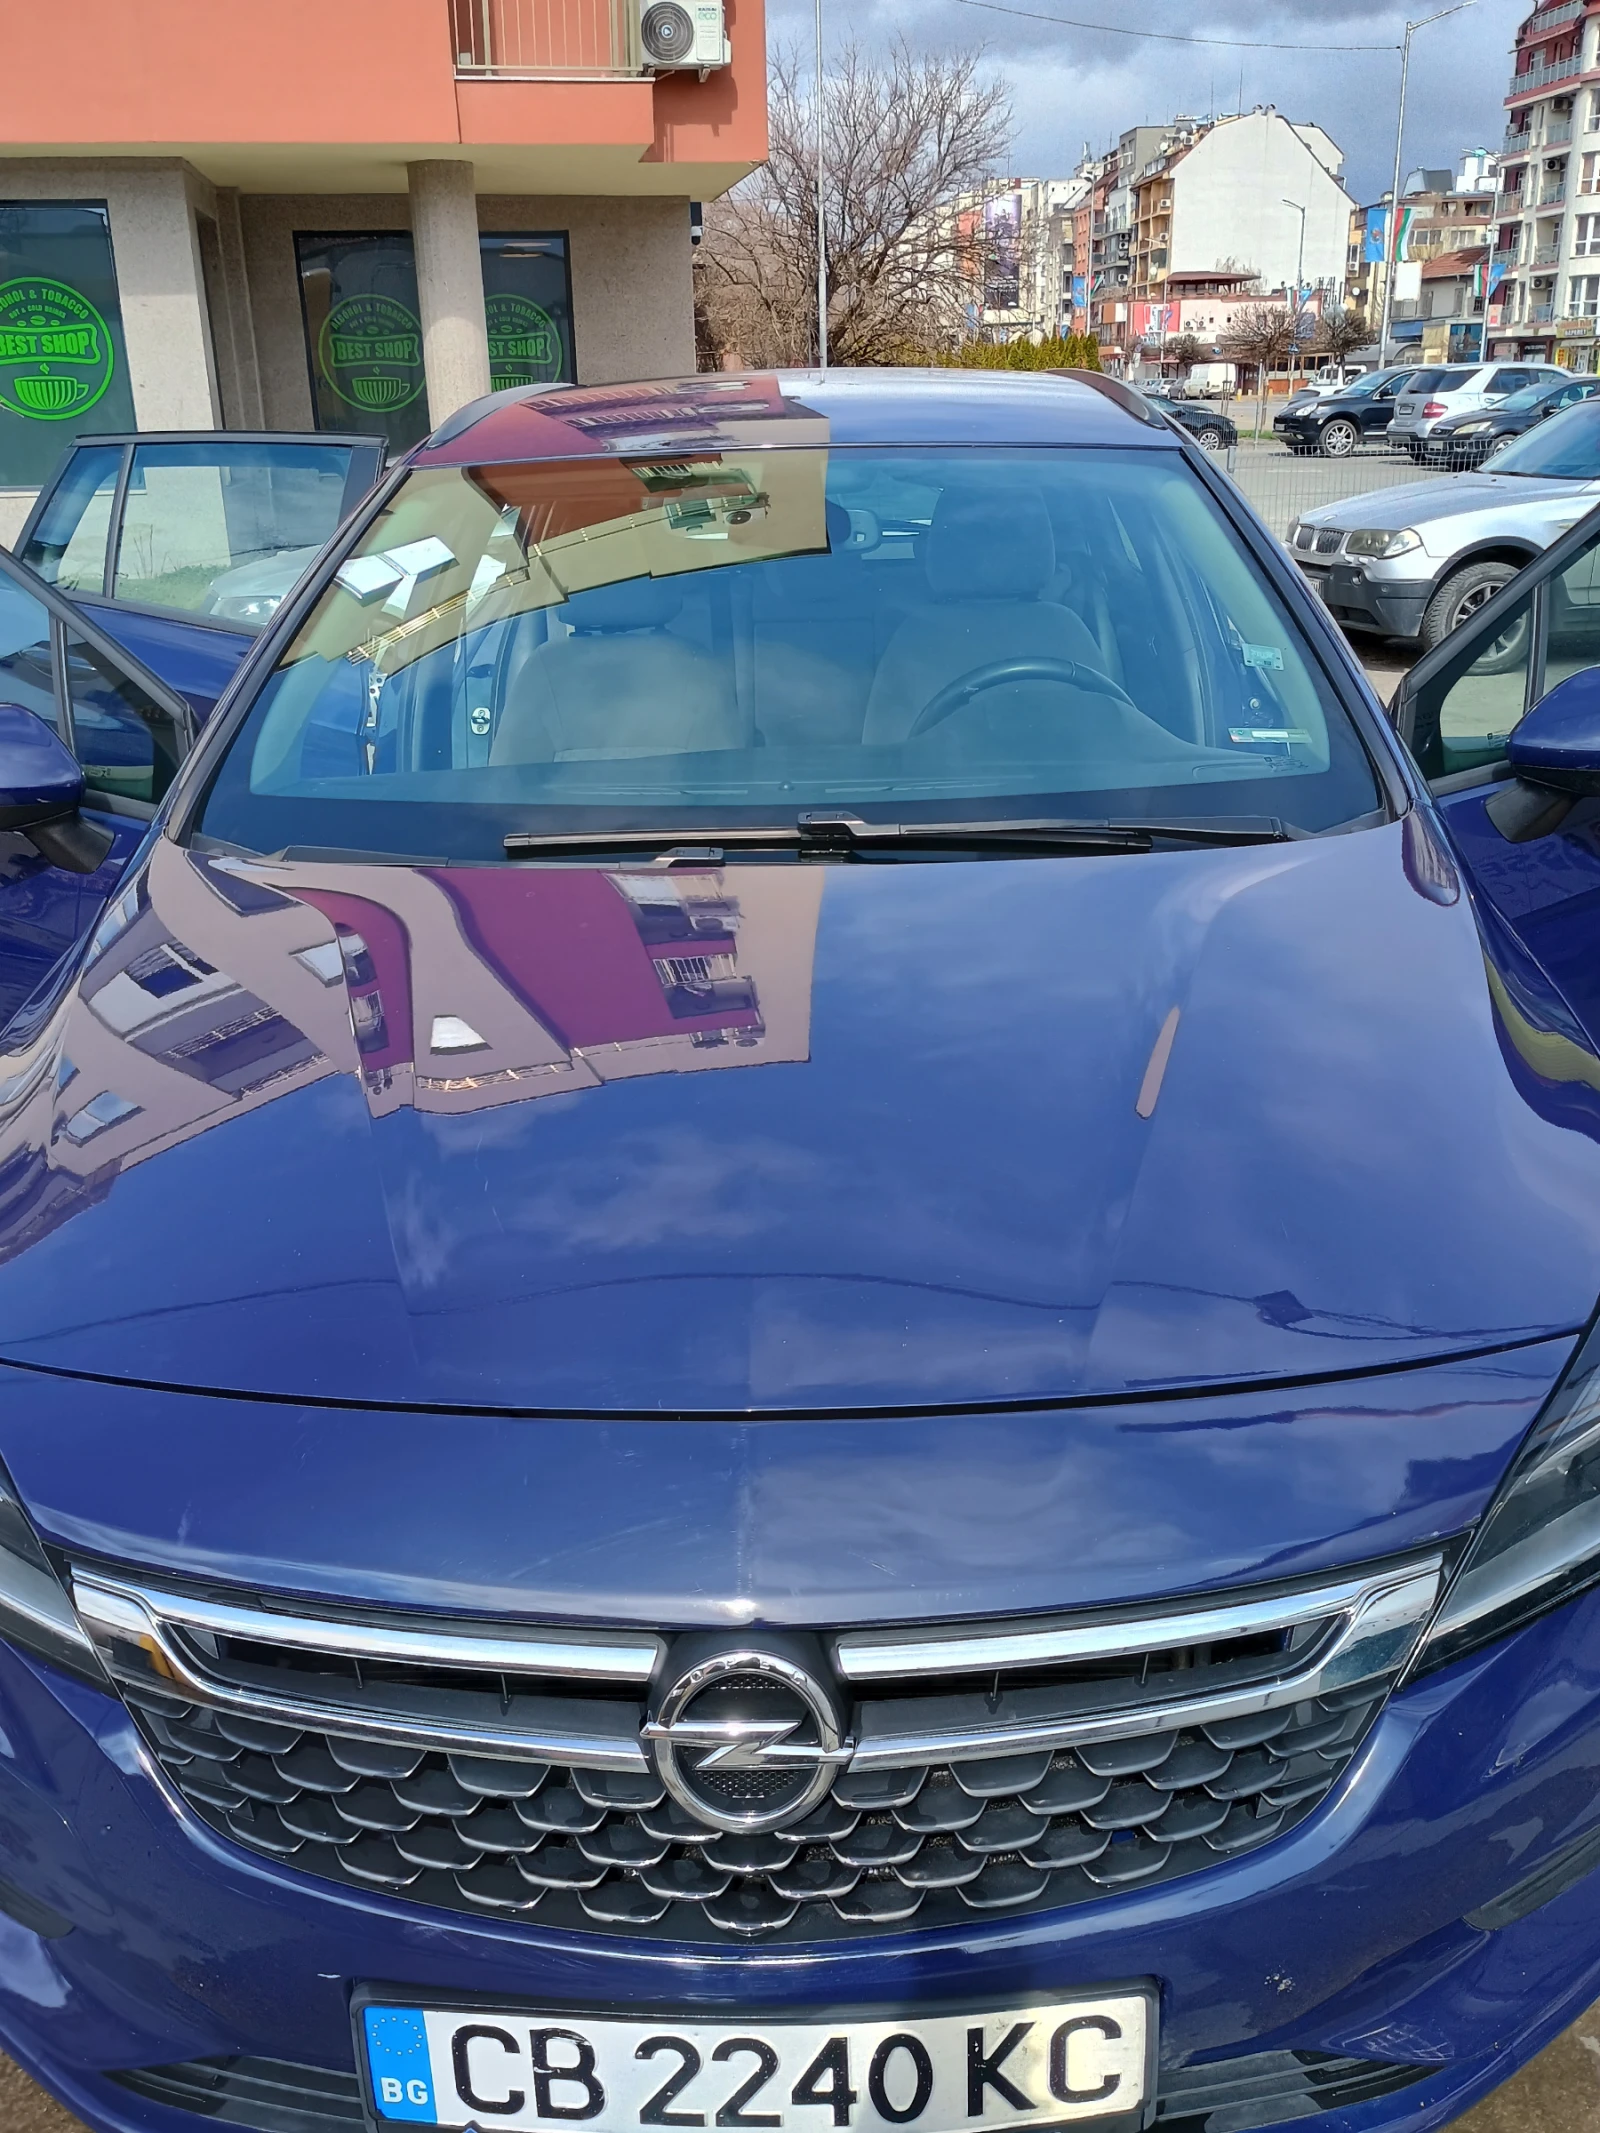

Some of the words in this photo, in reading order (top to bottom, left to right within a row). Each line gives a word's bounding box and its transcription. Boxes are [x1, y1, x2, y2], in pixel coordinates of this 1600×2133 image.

[29, 289, 37, 299] &
[41, 288, 89, 320] TOBACCO
[331, 303, 363, 331] ALCOHOL
[376, 302, 413, 330] TOBACCO
[511, 302, 546, 328] TOBACCO
[0, 334, 37, 357] BEST
[41, 332, 89, 355] SHOP
[336, 341, 372, 361] BEST
[375, 340, 413, 359] SHOP
[507, 338, 545, 357] SHOP
[452, 2023, 606, 2121] CB
[634, 2032, 934, 2128] 2240
[966, 2014, 1123, 2118] KC
[380, 2076, 429, 2106] BG
